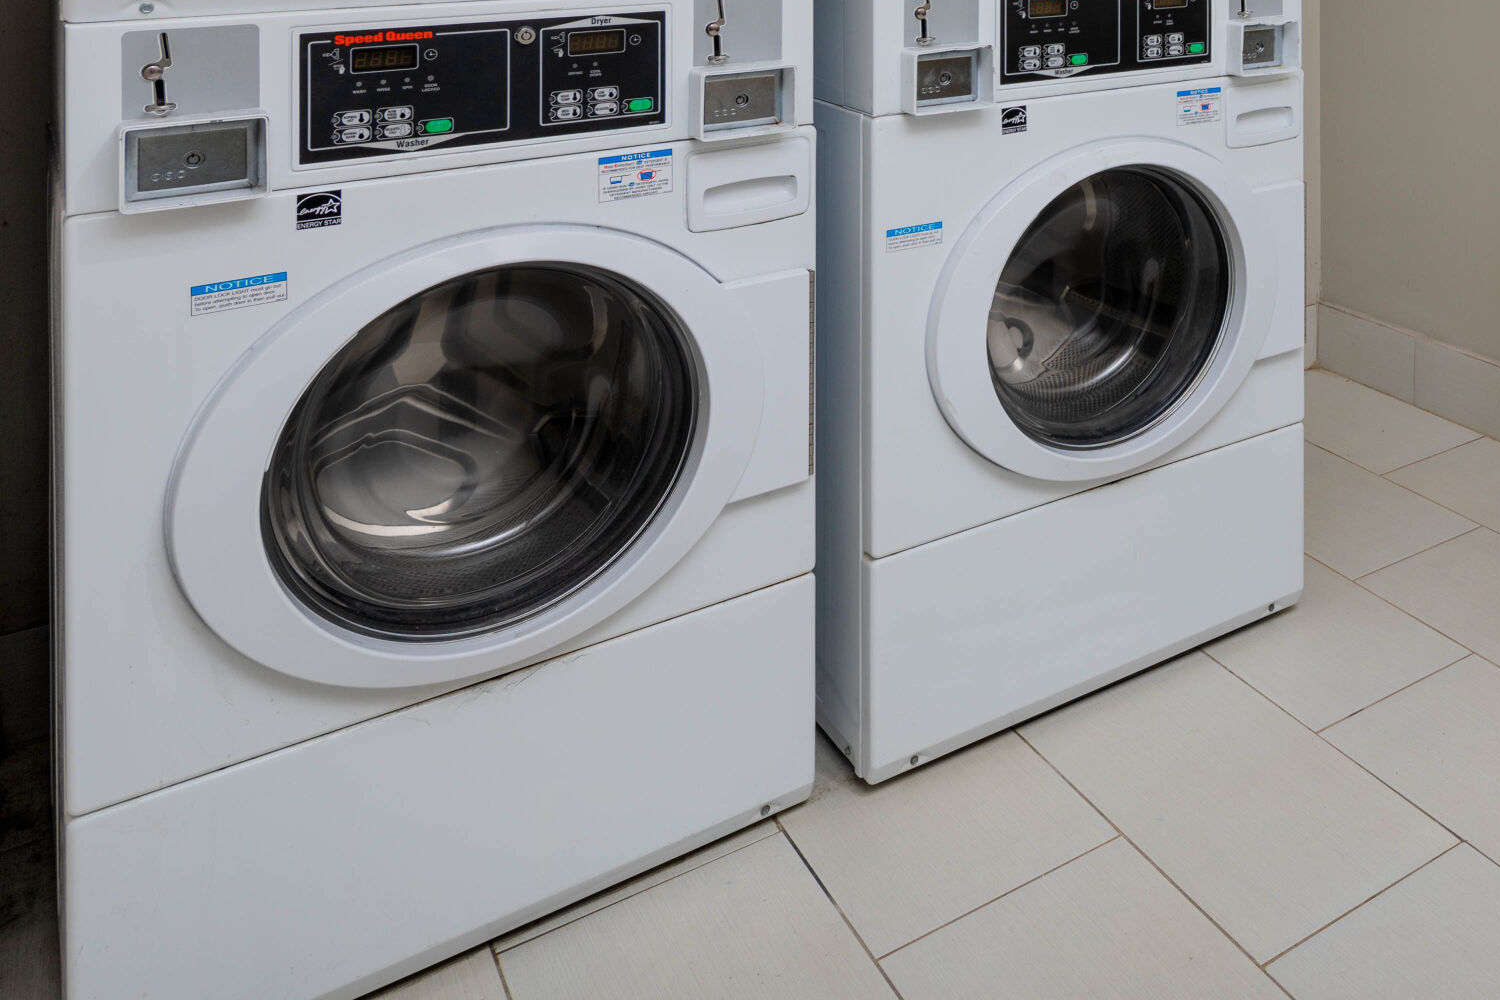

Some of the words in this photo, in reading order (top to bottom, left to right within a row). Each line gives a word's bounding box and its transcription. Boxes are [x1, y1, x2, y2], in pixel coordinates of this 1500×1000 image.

[591, 17, 611, 26] Dryer
[334, 33, 383, 46] Speed
[386, 31, 433, 41] Queen
[1054, 68, 1074, 76] Washer
[396, 139, 429, 148] Washer
[297, 221, 323, 229] ENERGY
[895, 224, 935, 235] NOTICE
[205, 275, 275, 292] NOTICE
[213, 296, 241, 304] attempting
